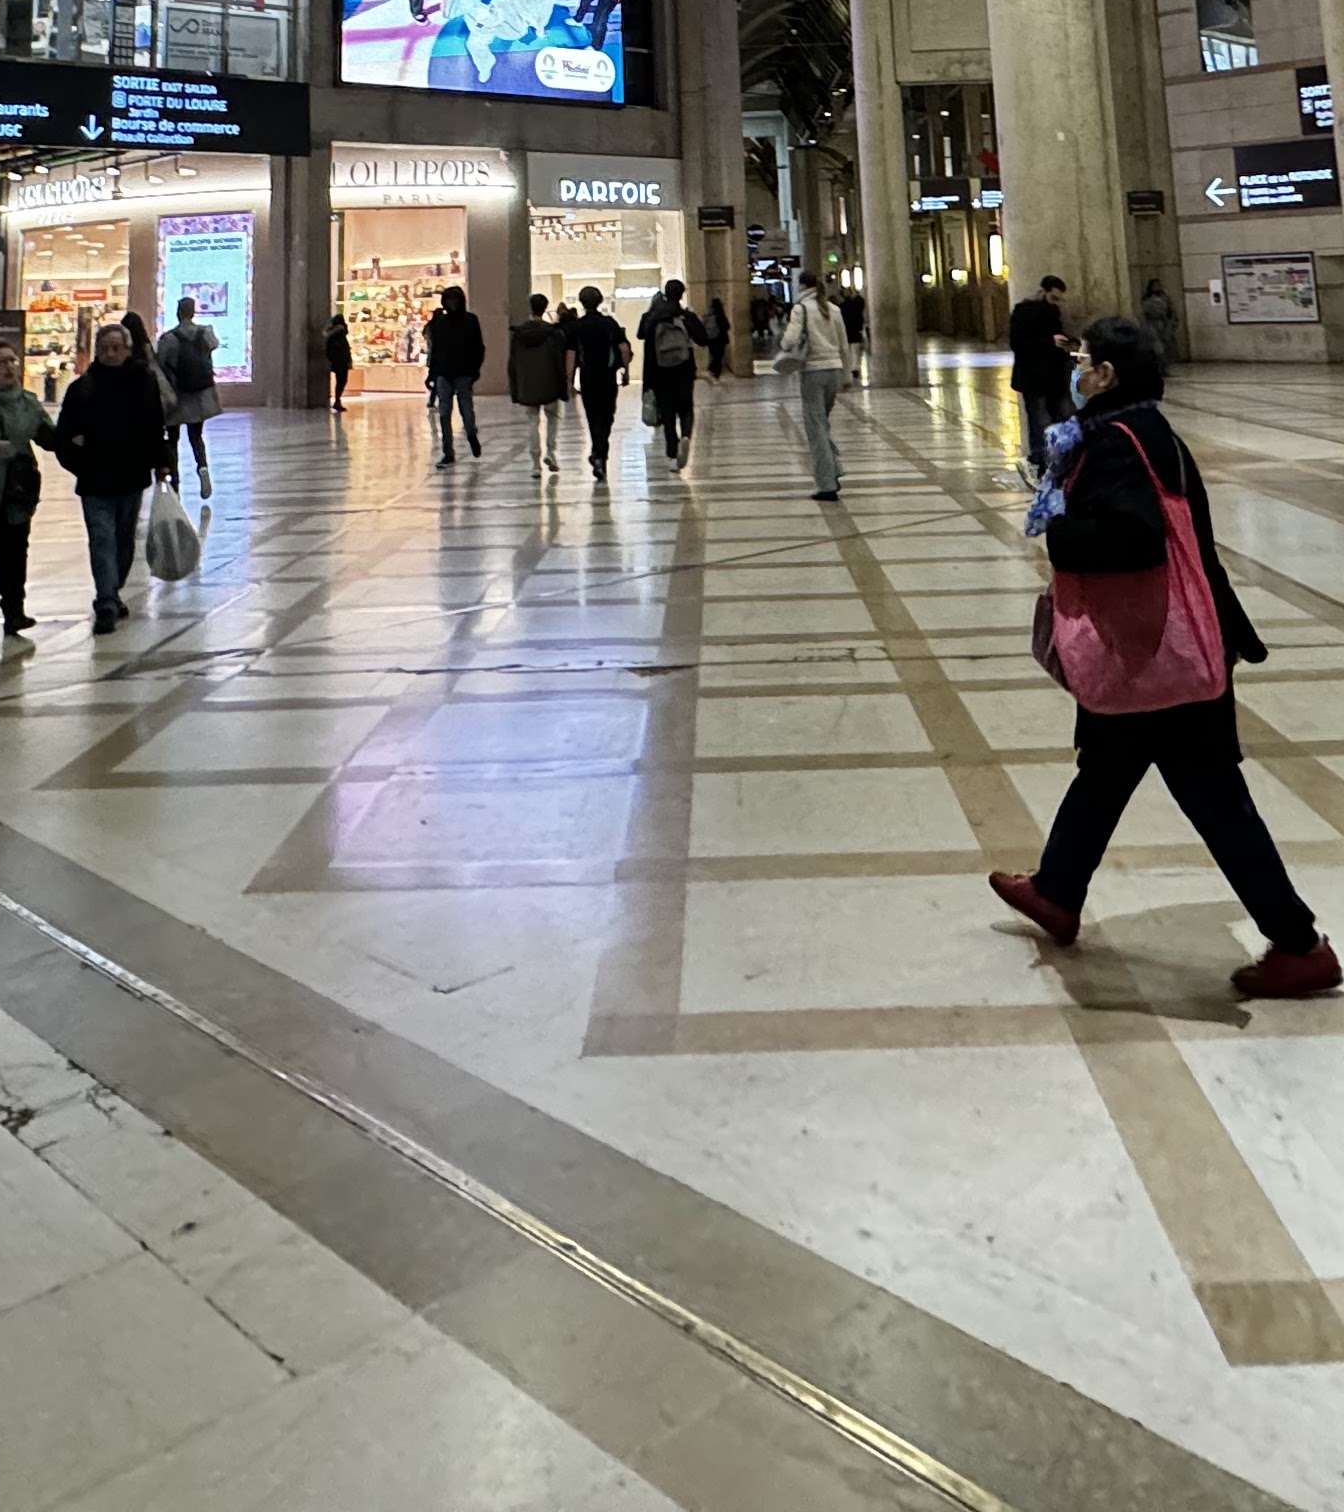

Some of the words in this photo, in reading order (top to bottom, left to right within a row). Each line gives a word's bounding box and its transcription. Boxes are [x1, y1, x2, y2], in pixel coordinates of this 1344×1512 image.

[113, 75, 160, 91] SORTIE
[128, 95, 165, 108] PORTE
[166, 96, 184, 110] DU
[185, 98, 228, 112] LOUVRE
[112, 117, 157, 131] Bourse
[158, 120, 175, 132] de
[177, 123, 240, 136] commerce
[331, 159, 491, 187] LOLLIPOPS
[559, 177, 662, 206] PARFOIS
